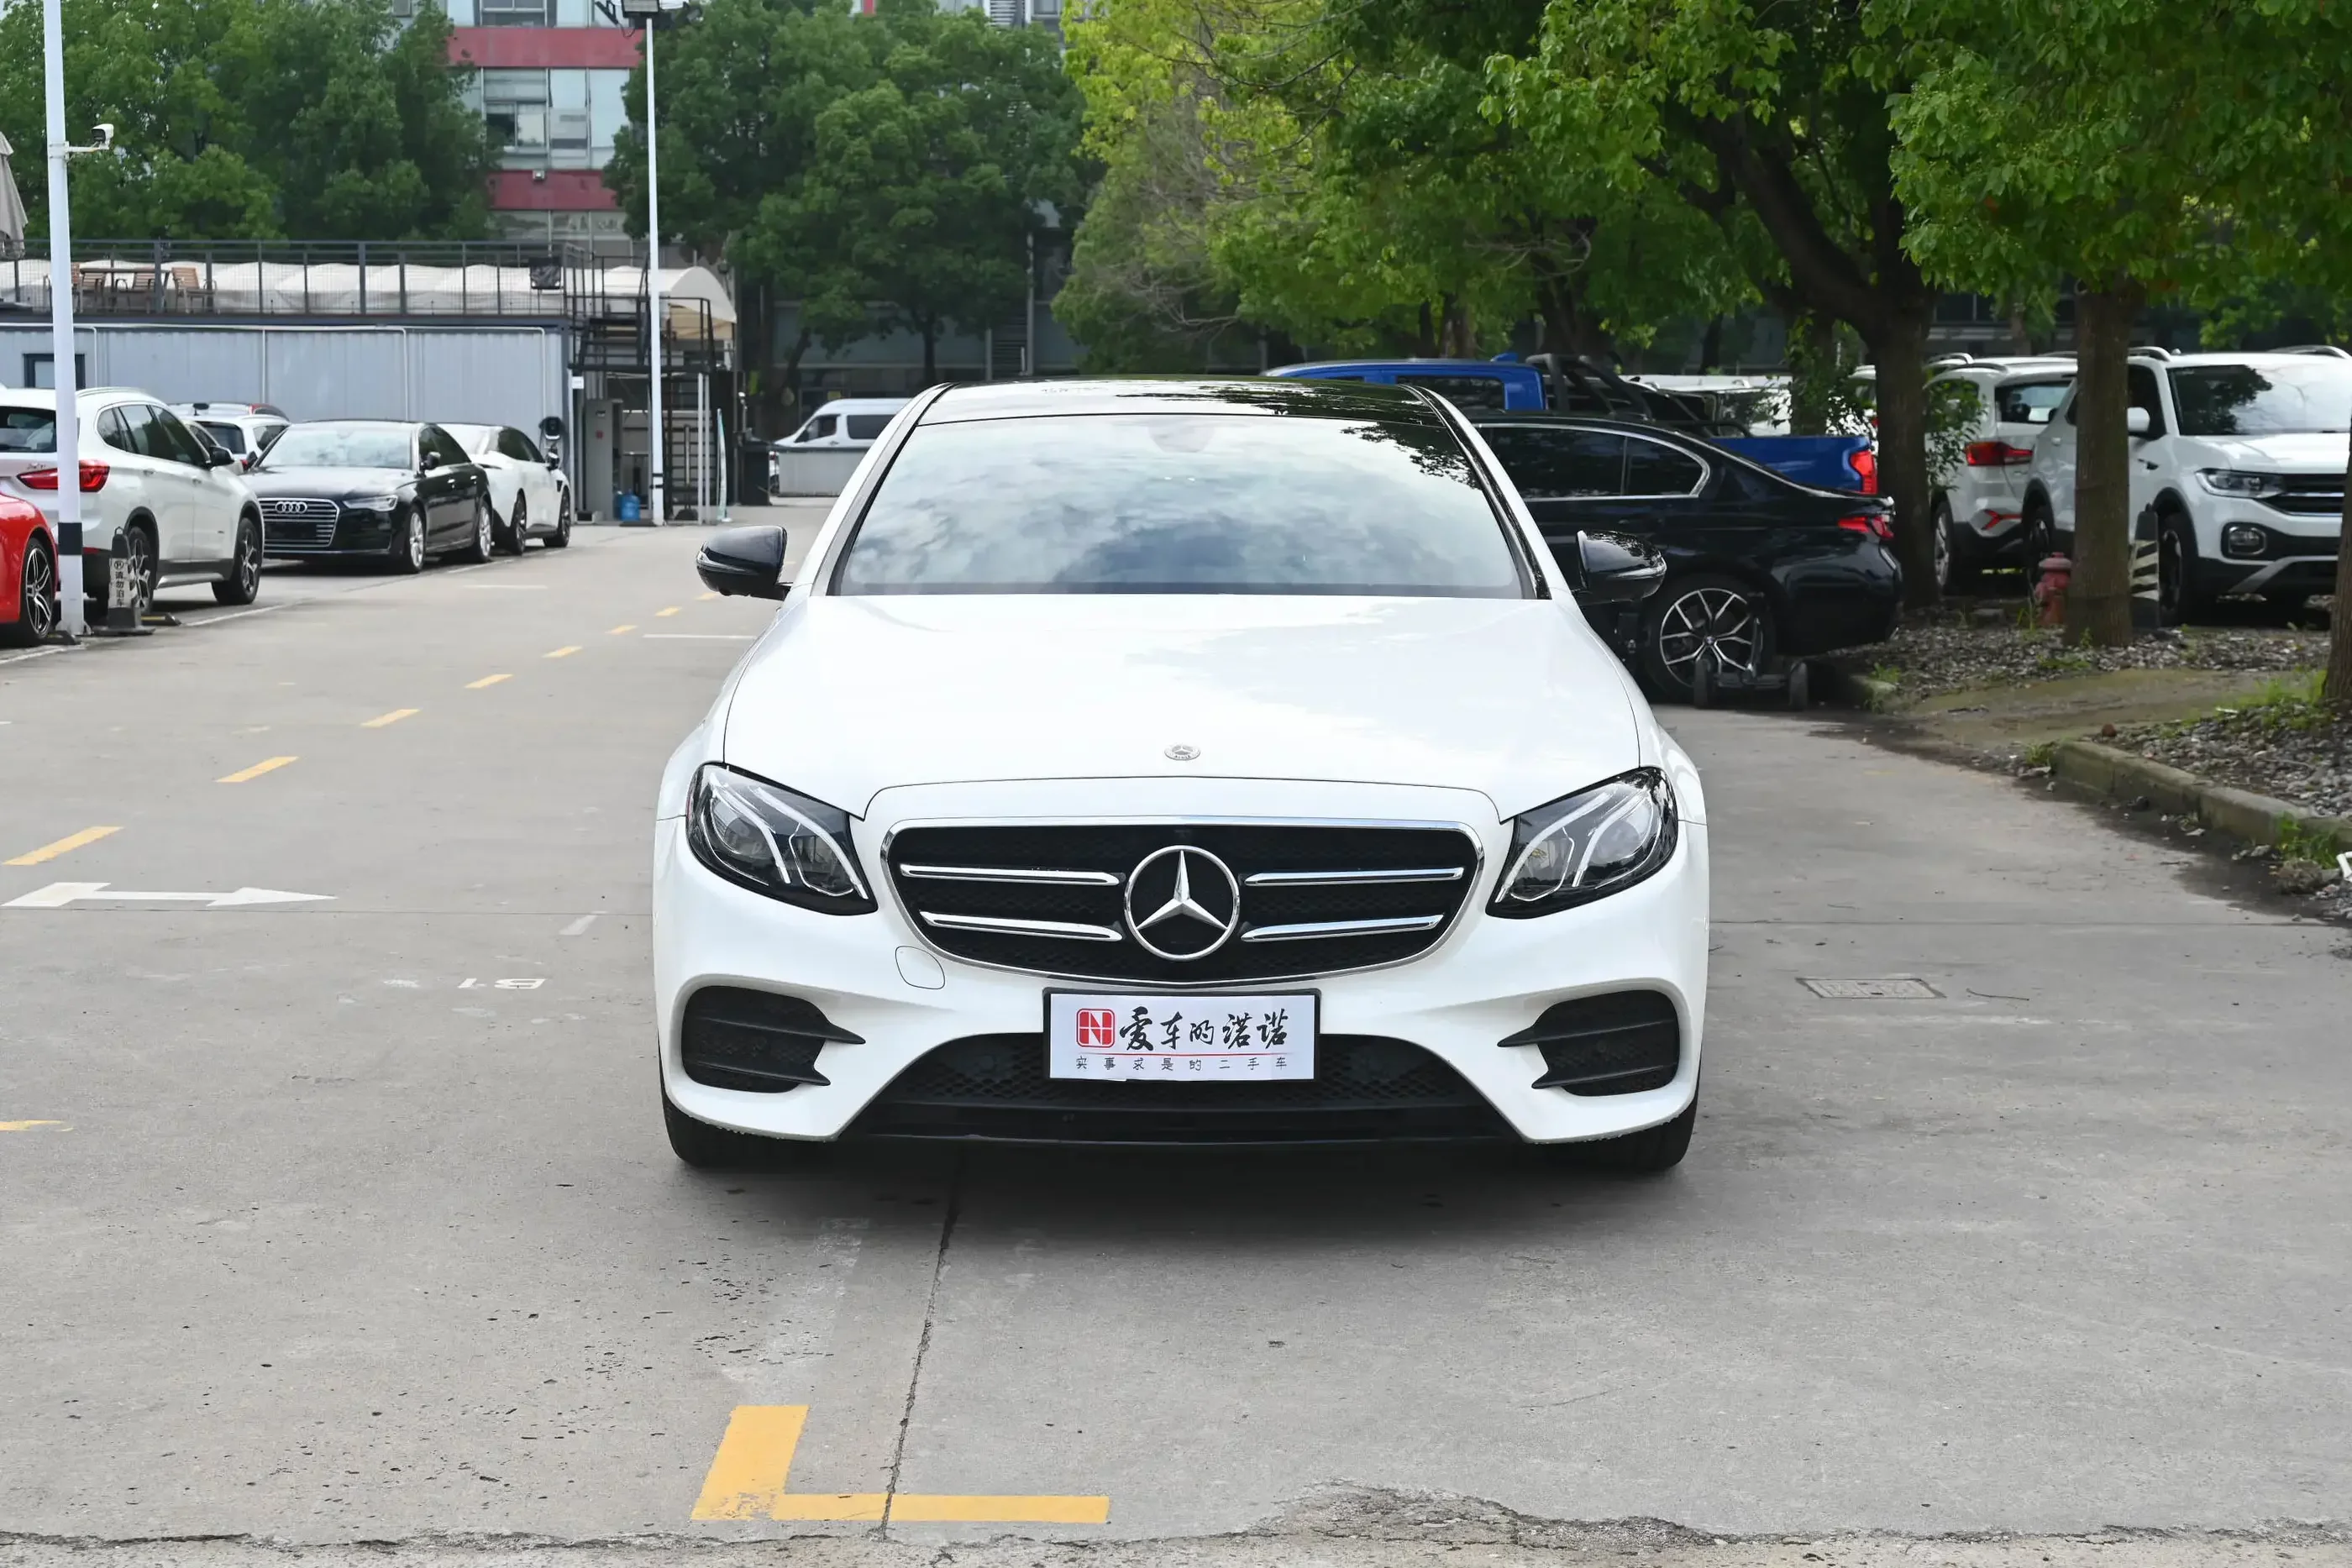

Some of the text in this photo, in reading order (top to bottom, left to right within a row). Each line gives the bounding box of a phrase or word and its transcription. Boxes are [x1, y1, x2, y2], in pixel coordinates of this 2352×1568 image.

[1075, 1056, 1288, 1072] 实事求是的二手车
